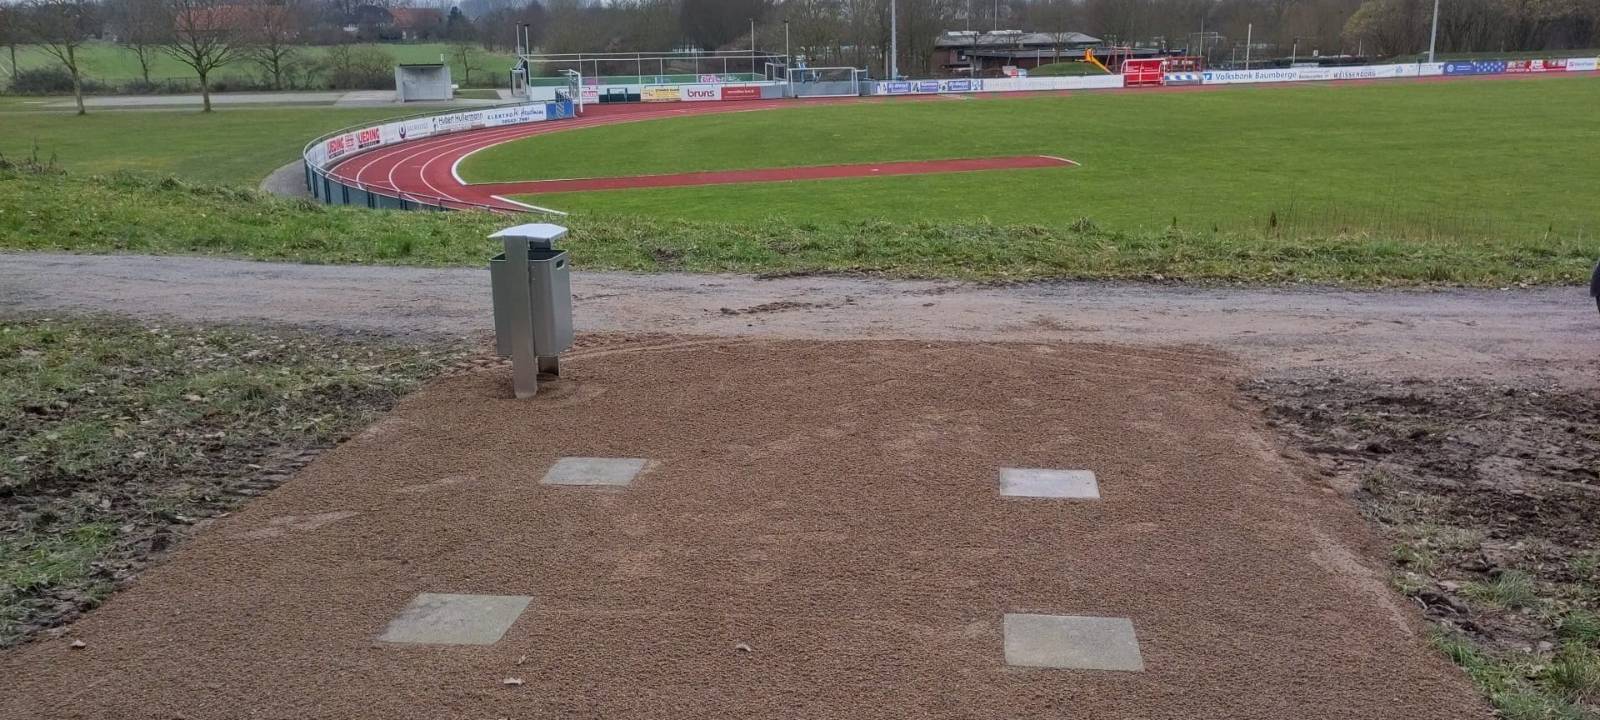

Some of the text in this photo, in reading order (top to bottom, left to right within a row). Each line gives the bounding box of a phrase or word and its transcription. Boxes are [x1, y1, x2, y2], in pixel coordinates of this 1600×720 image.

[1215, 70, 1252, 80] Volksbank
[1255, 70, 1297, 80] Baumberge
[687, 87, 715, 98] bruns
